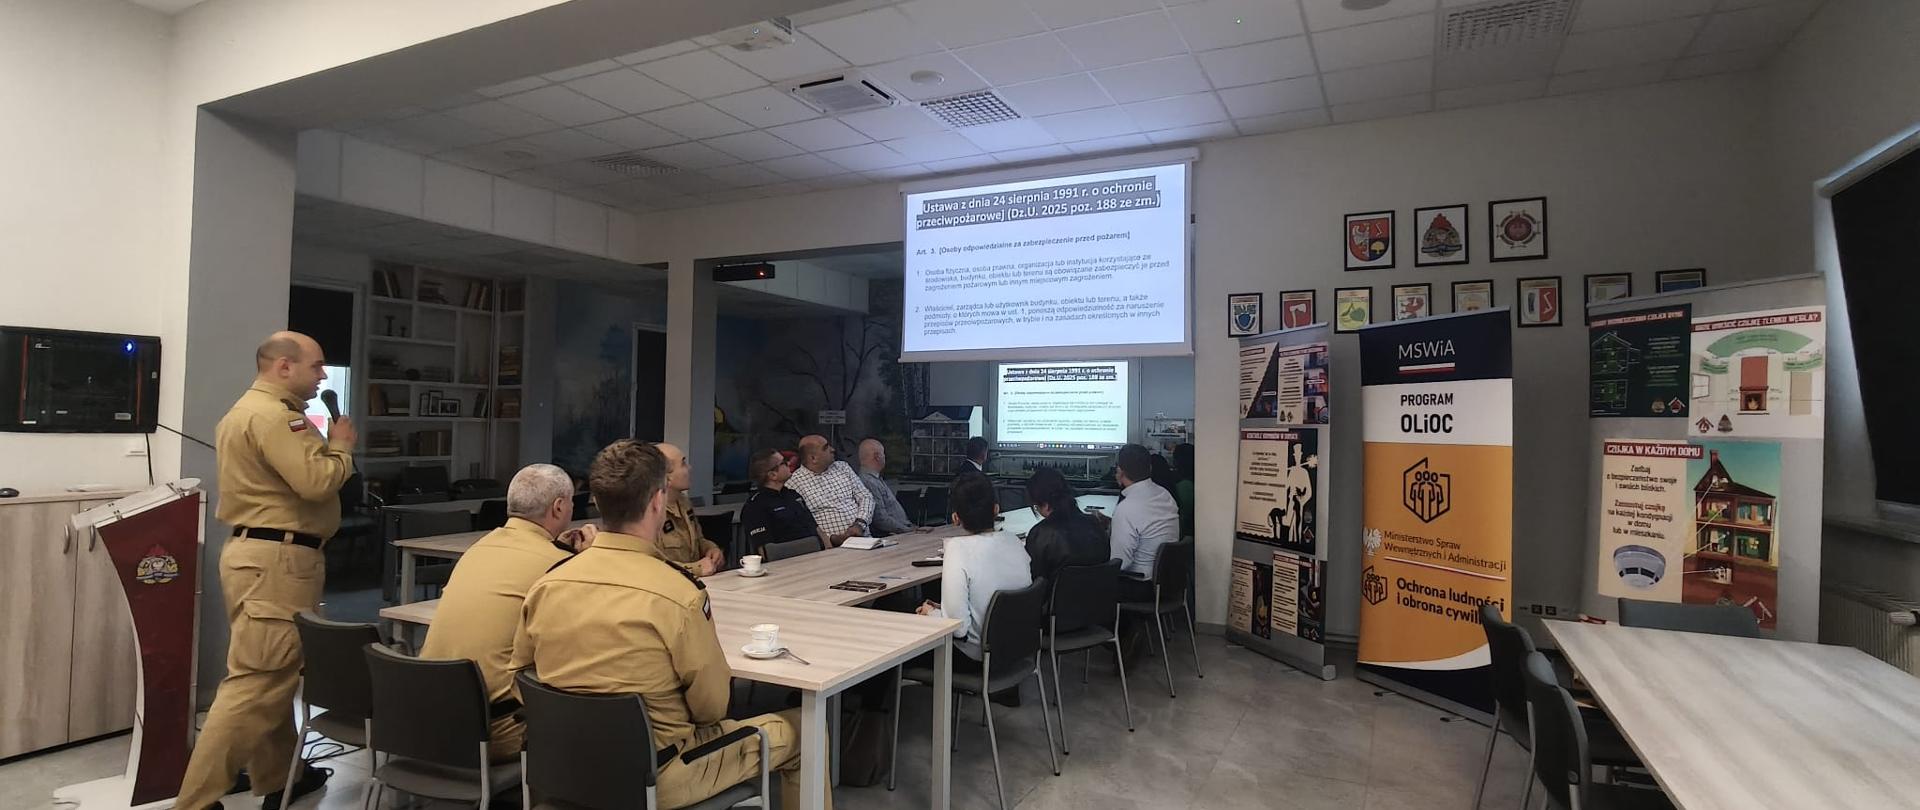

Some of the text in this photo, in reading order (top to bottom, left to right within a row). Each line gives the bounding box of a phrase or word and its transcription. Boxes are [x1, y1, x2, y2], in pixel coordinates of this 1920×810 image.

[923, 202, 958, 213] Ustawa
[969, 198, 990, 208] dnia
[993, 195, 1005, 206] 24
[1008, 191, 1049, 204] sierpnia
[1053, 188, 1079, 199] 1991
[1082, 189, 1088, 197] r.
[1092, 187, 1099, 196] o
[1102, 180, 1153, 195] ochronie
[916, 194, 1160, 229] przeciwpożarowej (Dz.U. 2025 poz. 188 ze zm.)
[963, 240, 1012, 252] odpowiedzialne
[1023, 236, 1074, 247] zabezpieczenie
[1075, 234, 1095, 244] przed
[1398, 339, 1456, 360] MSWiA
[1400, 392, 1454, 406] PROGRAM
[1401, 413, 1453, 433] OLiOC
[1607, 443, 1700, 457] CZUJKA W KAŻDYM DOMU
[1384, 530, 1461, 550] Ministerstwo Spraw
[1384, 541, 1442, 560] Wewnętrznych
[1448, 551, 1506, 572] Administracji
[1397, 577, 1446, 599] Ochrona
[1397, 593, 1400, 605] i
[1403, 594, 1443, 615] obrona
